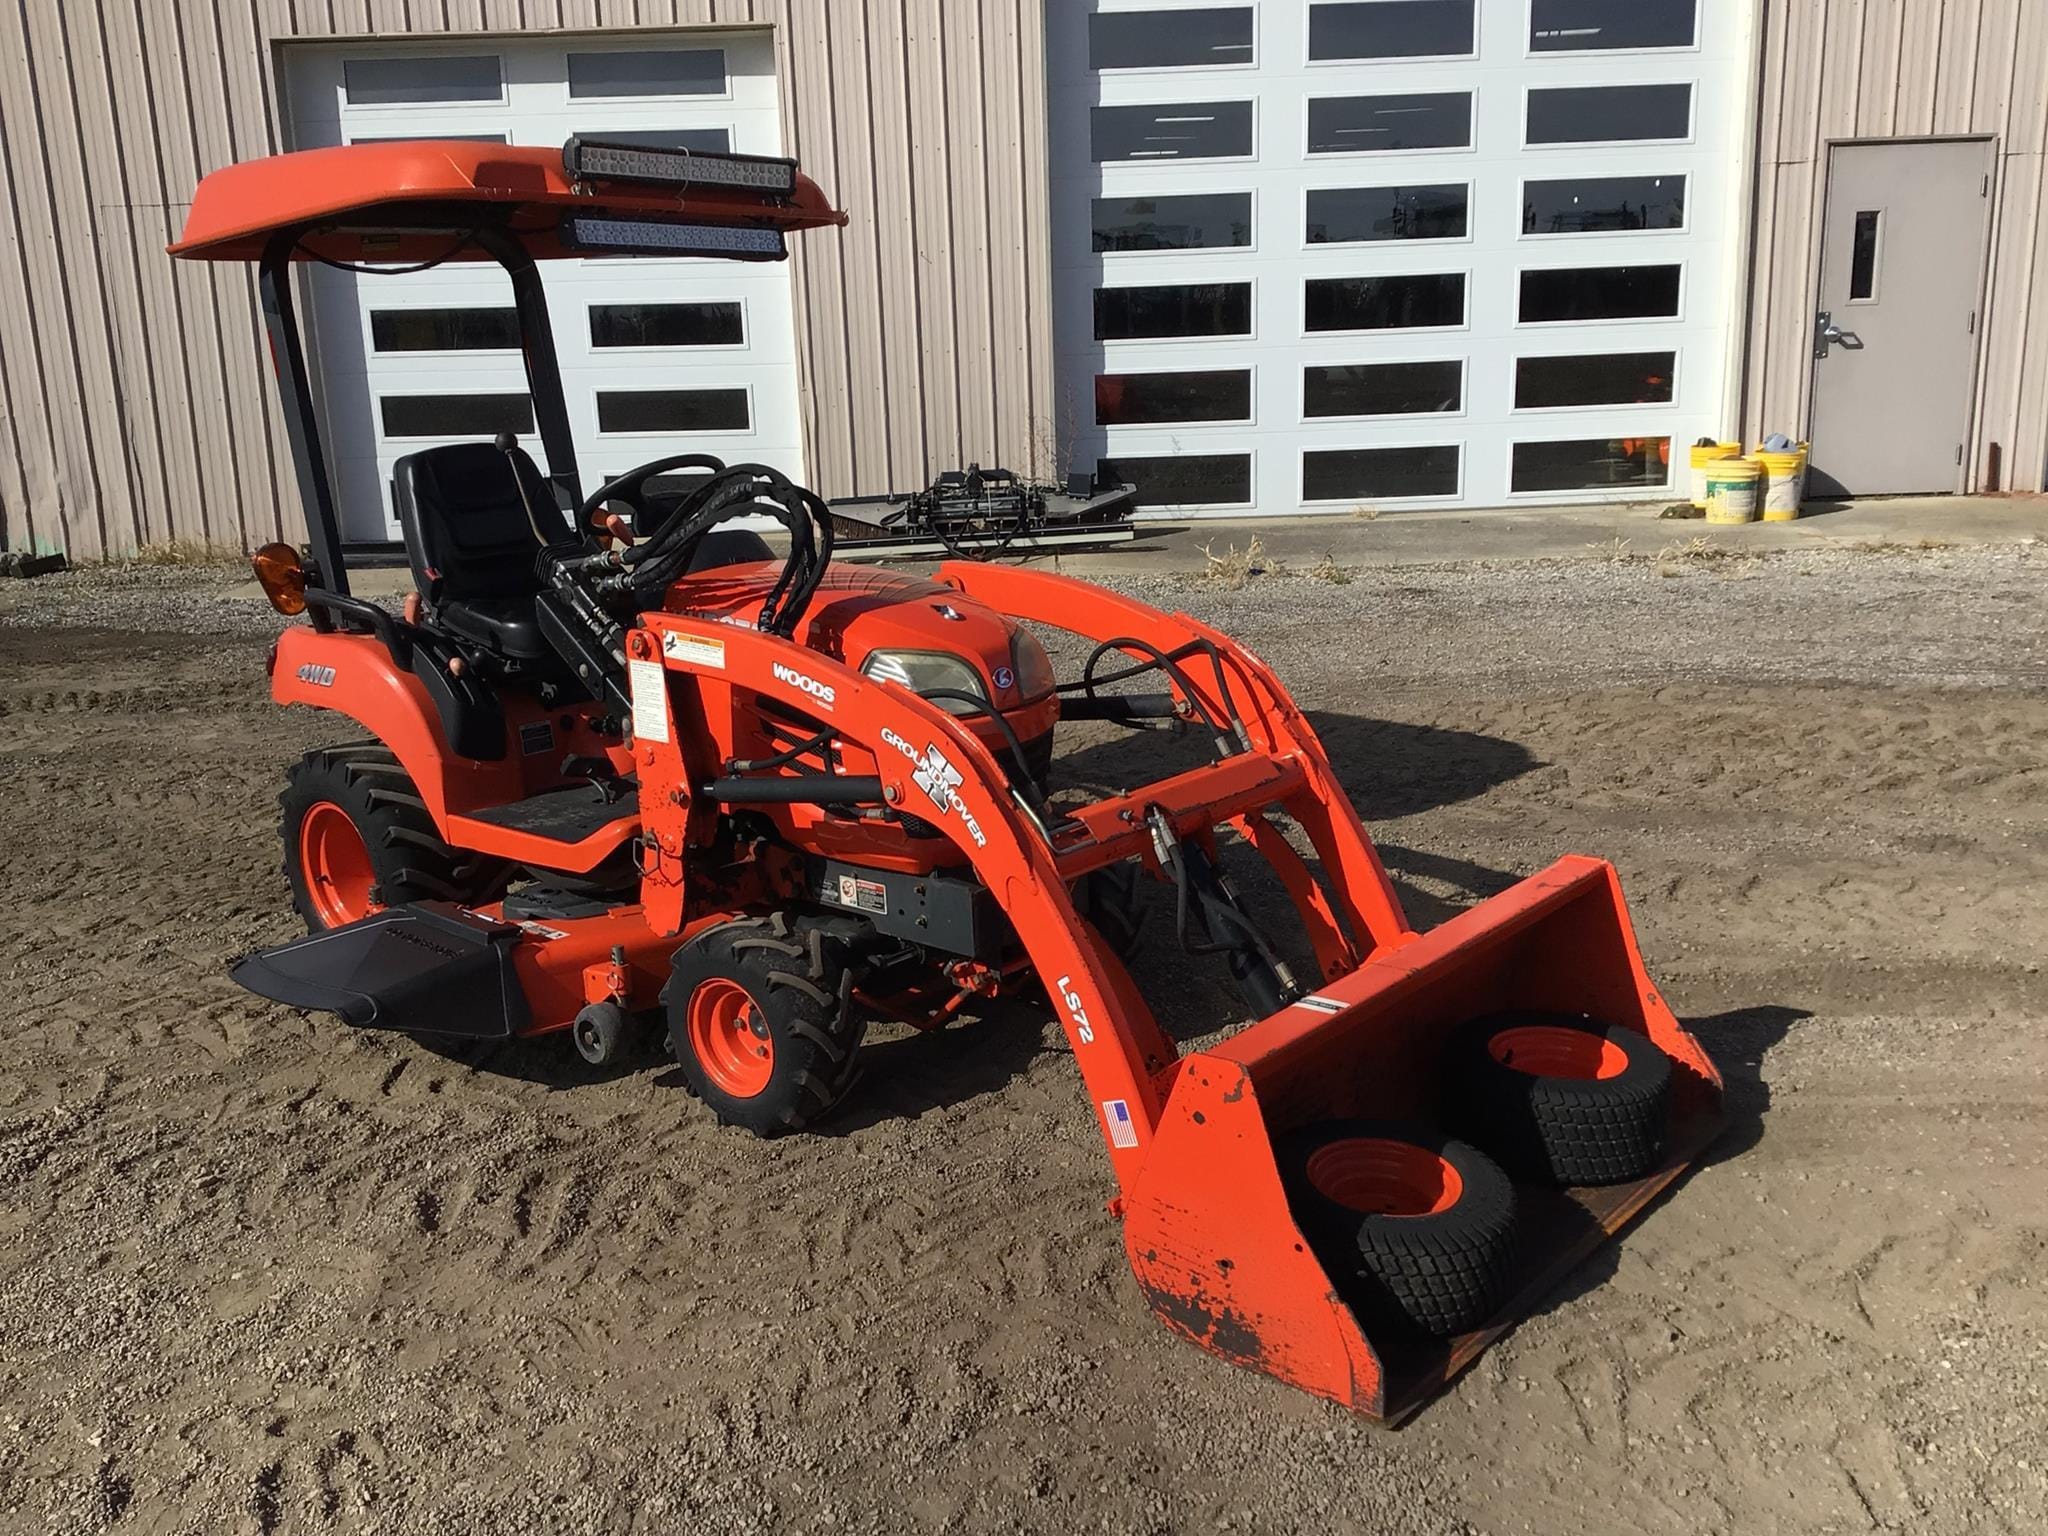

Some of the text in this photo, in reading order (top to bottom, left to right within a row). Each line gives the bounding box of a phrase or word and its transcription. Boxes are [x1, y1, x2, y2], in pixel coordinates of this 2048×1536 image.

[297, 663, 336, 687] 4WD
[772, 661, 836, 703] WOODS
[1056, 975, 1095, 1045] LS72
